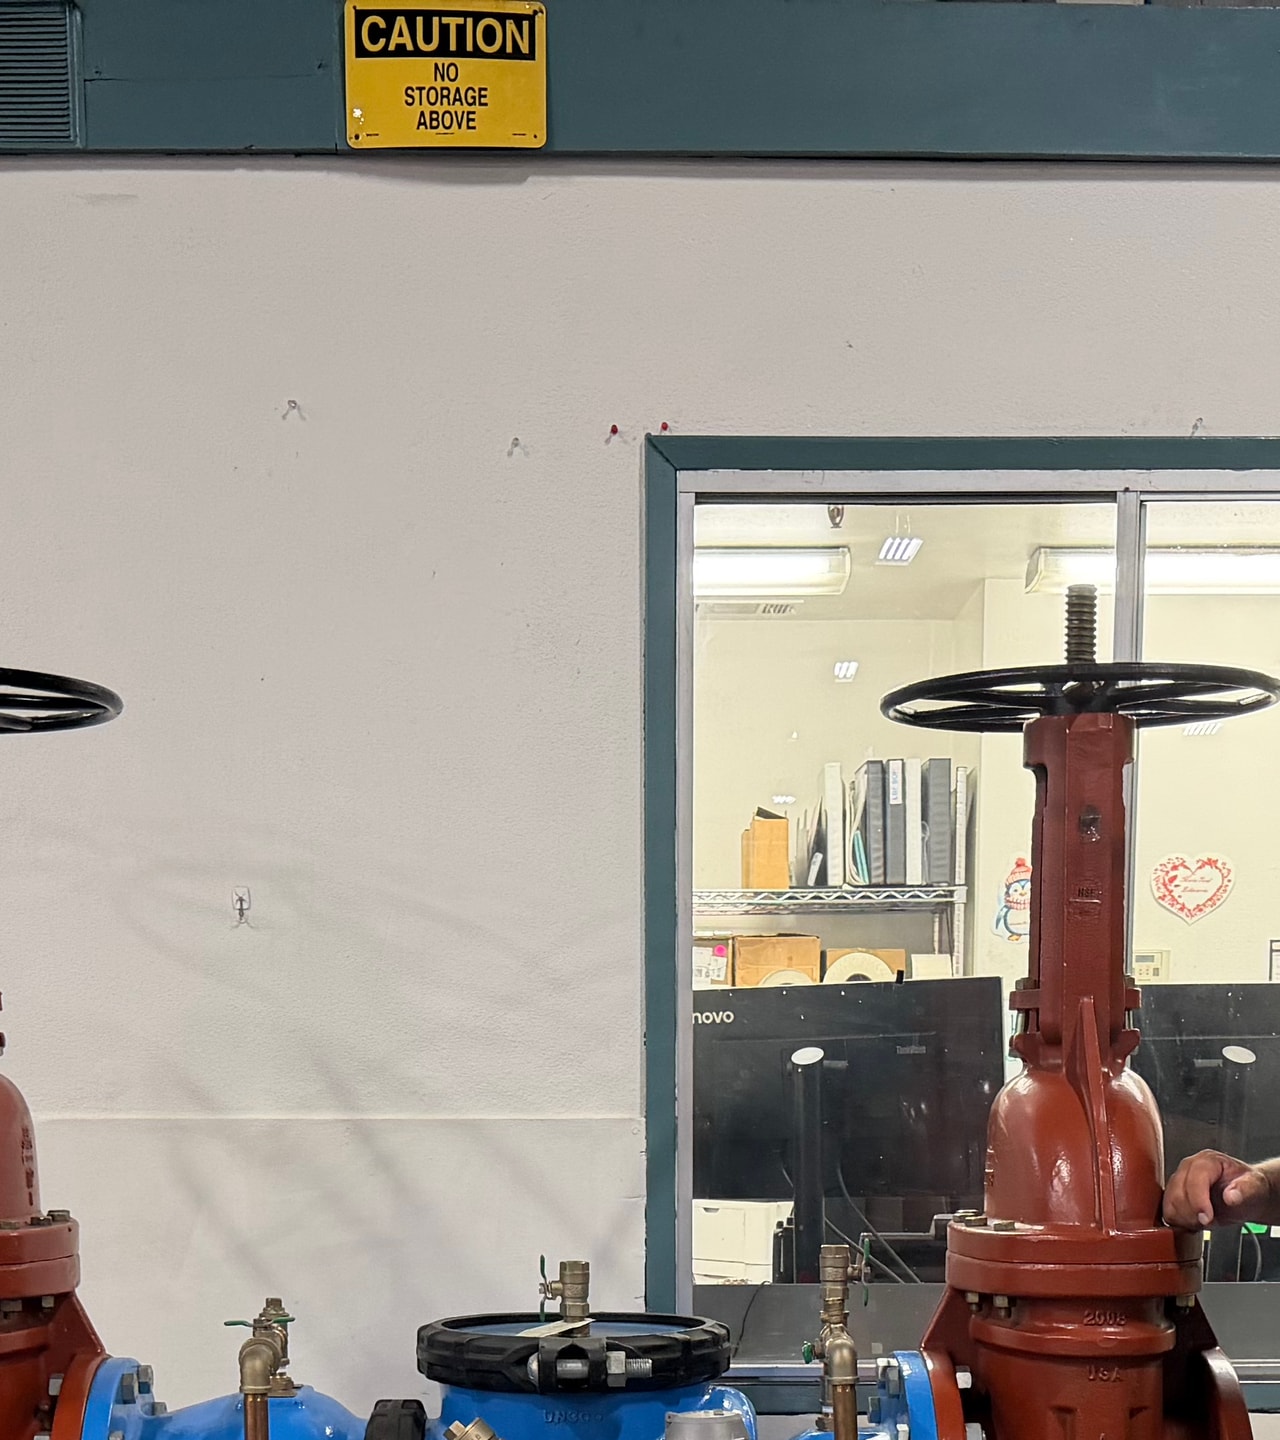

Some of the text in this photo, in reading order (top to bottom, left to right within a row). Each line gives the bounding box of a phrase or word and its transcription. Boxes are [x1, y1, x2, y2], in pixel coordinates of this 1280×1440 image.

[361, 15, 530, 54] CAUTION
[434, 62, 459, 82] NO
[404, 86, 489, 107] STORAGE
[416, 110, 477, 130] ABOVE
